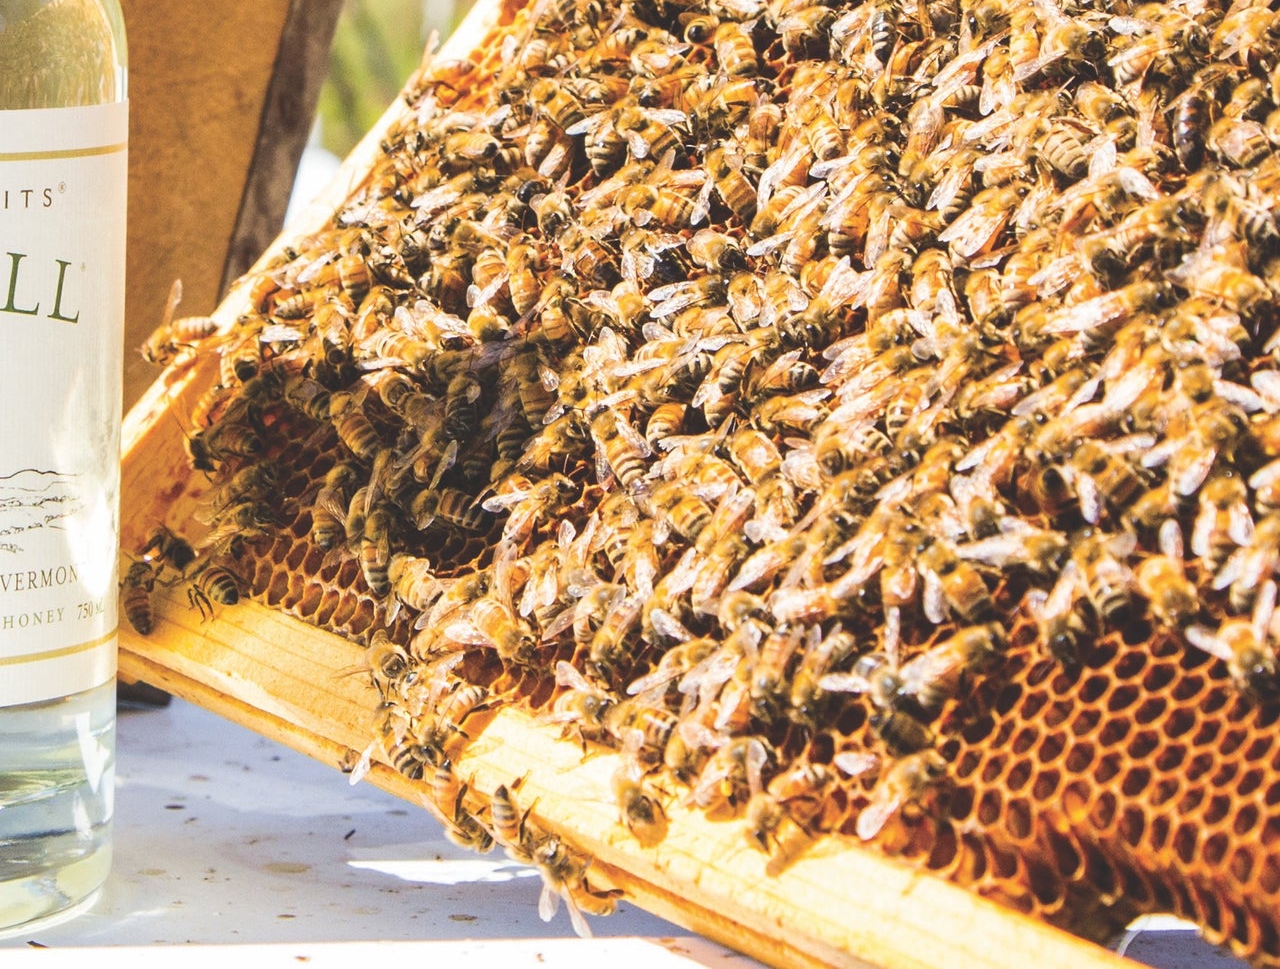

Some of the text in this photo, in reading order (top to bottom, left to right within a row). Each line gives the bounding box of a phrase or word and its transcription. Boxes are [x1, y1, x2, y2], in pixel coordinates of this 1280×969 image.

[0, 564, 78, 592] VERMON
[2, 607, 65, 629] HONEY
[77, 600, 95, 621] 750
